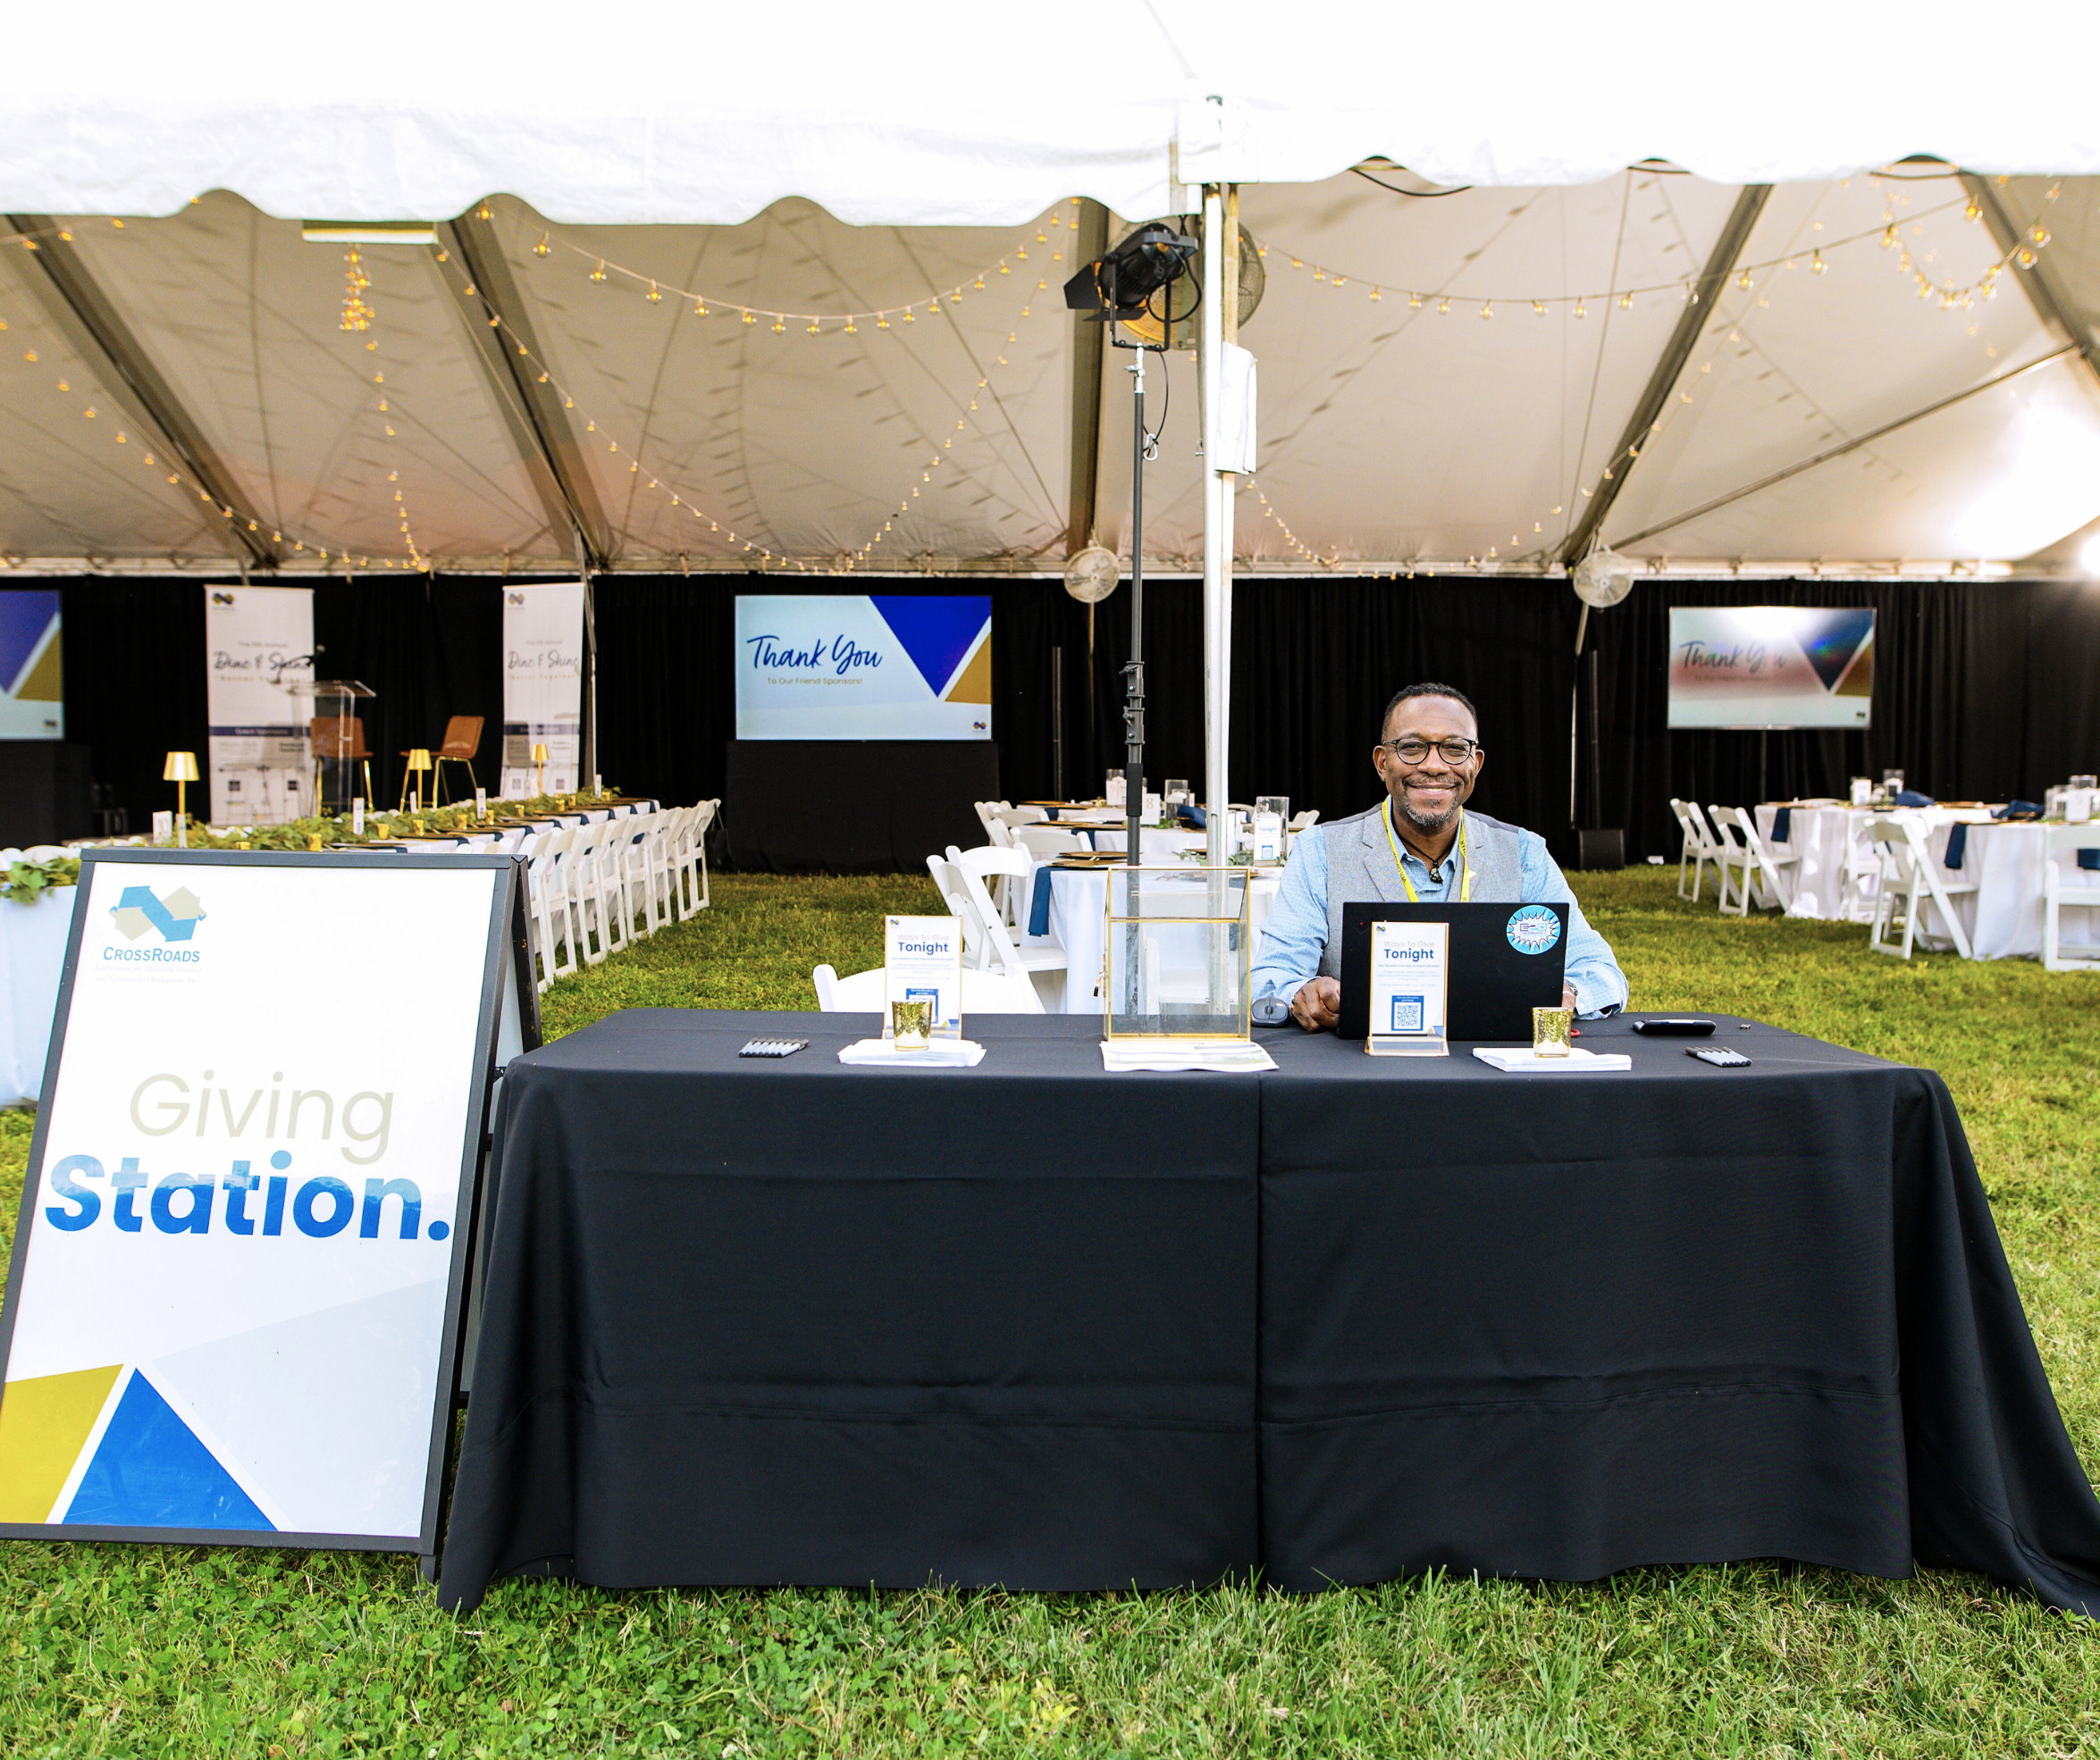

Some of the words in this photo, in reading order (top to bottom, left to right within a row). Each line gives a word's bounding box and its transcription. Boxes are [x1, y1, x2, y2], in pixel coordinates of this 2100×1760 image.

[746, 634, 827, 669] Thank
[832, 634, 883, 675] You
[1680, 641, 1743, 668] Thank
[778, 677, 794, 685] Our
[795, 676, 820, 685] Friend
[823, 677, 862, 686] Sponsors!
[1147, 798, 1154, 809] 8
[898, 934, 919, 942] Ways
[897, 942, 948, 955] Tonight
[1384, 948, 1434, 962] Tonight
[130, 1069, 394, 1165] Giving
[45, 1150, 450, 1241] Station.
